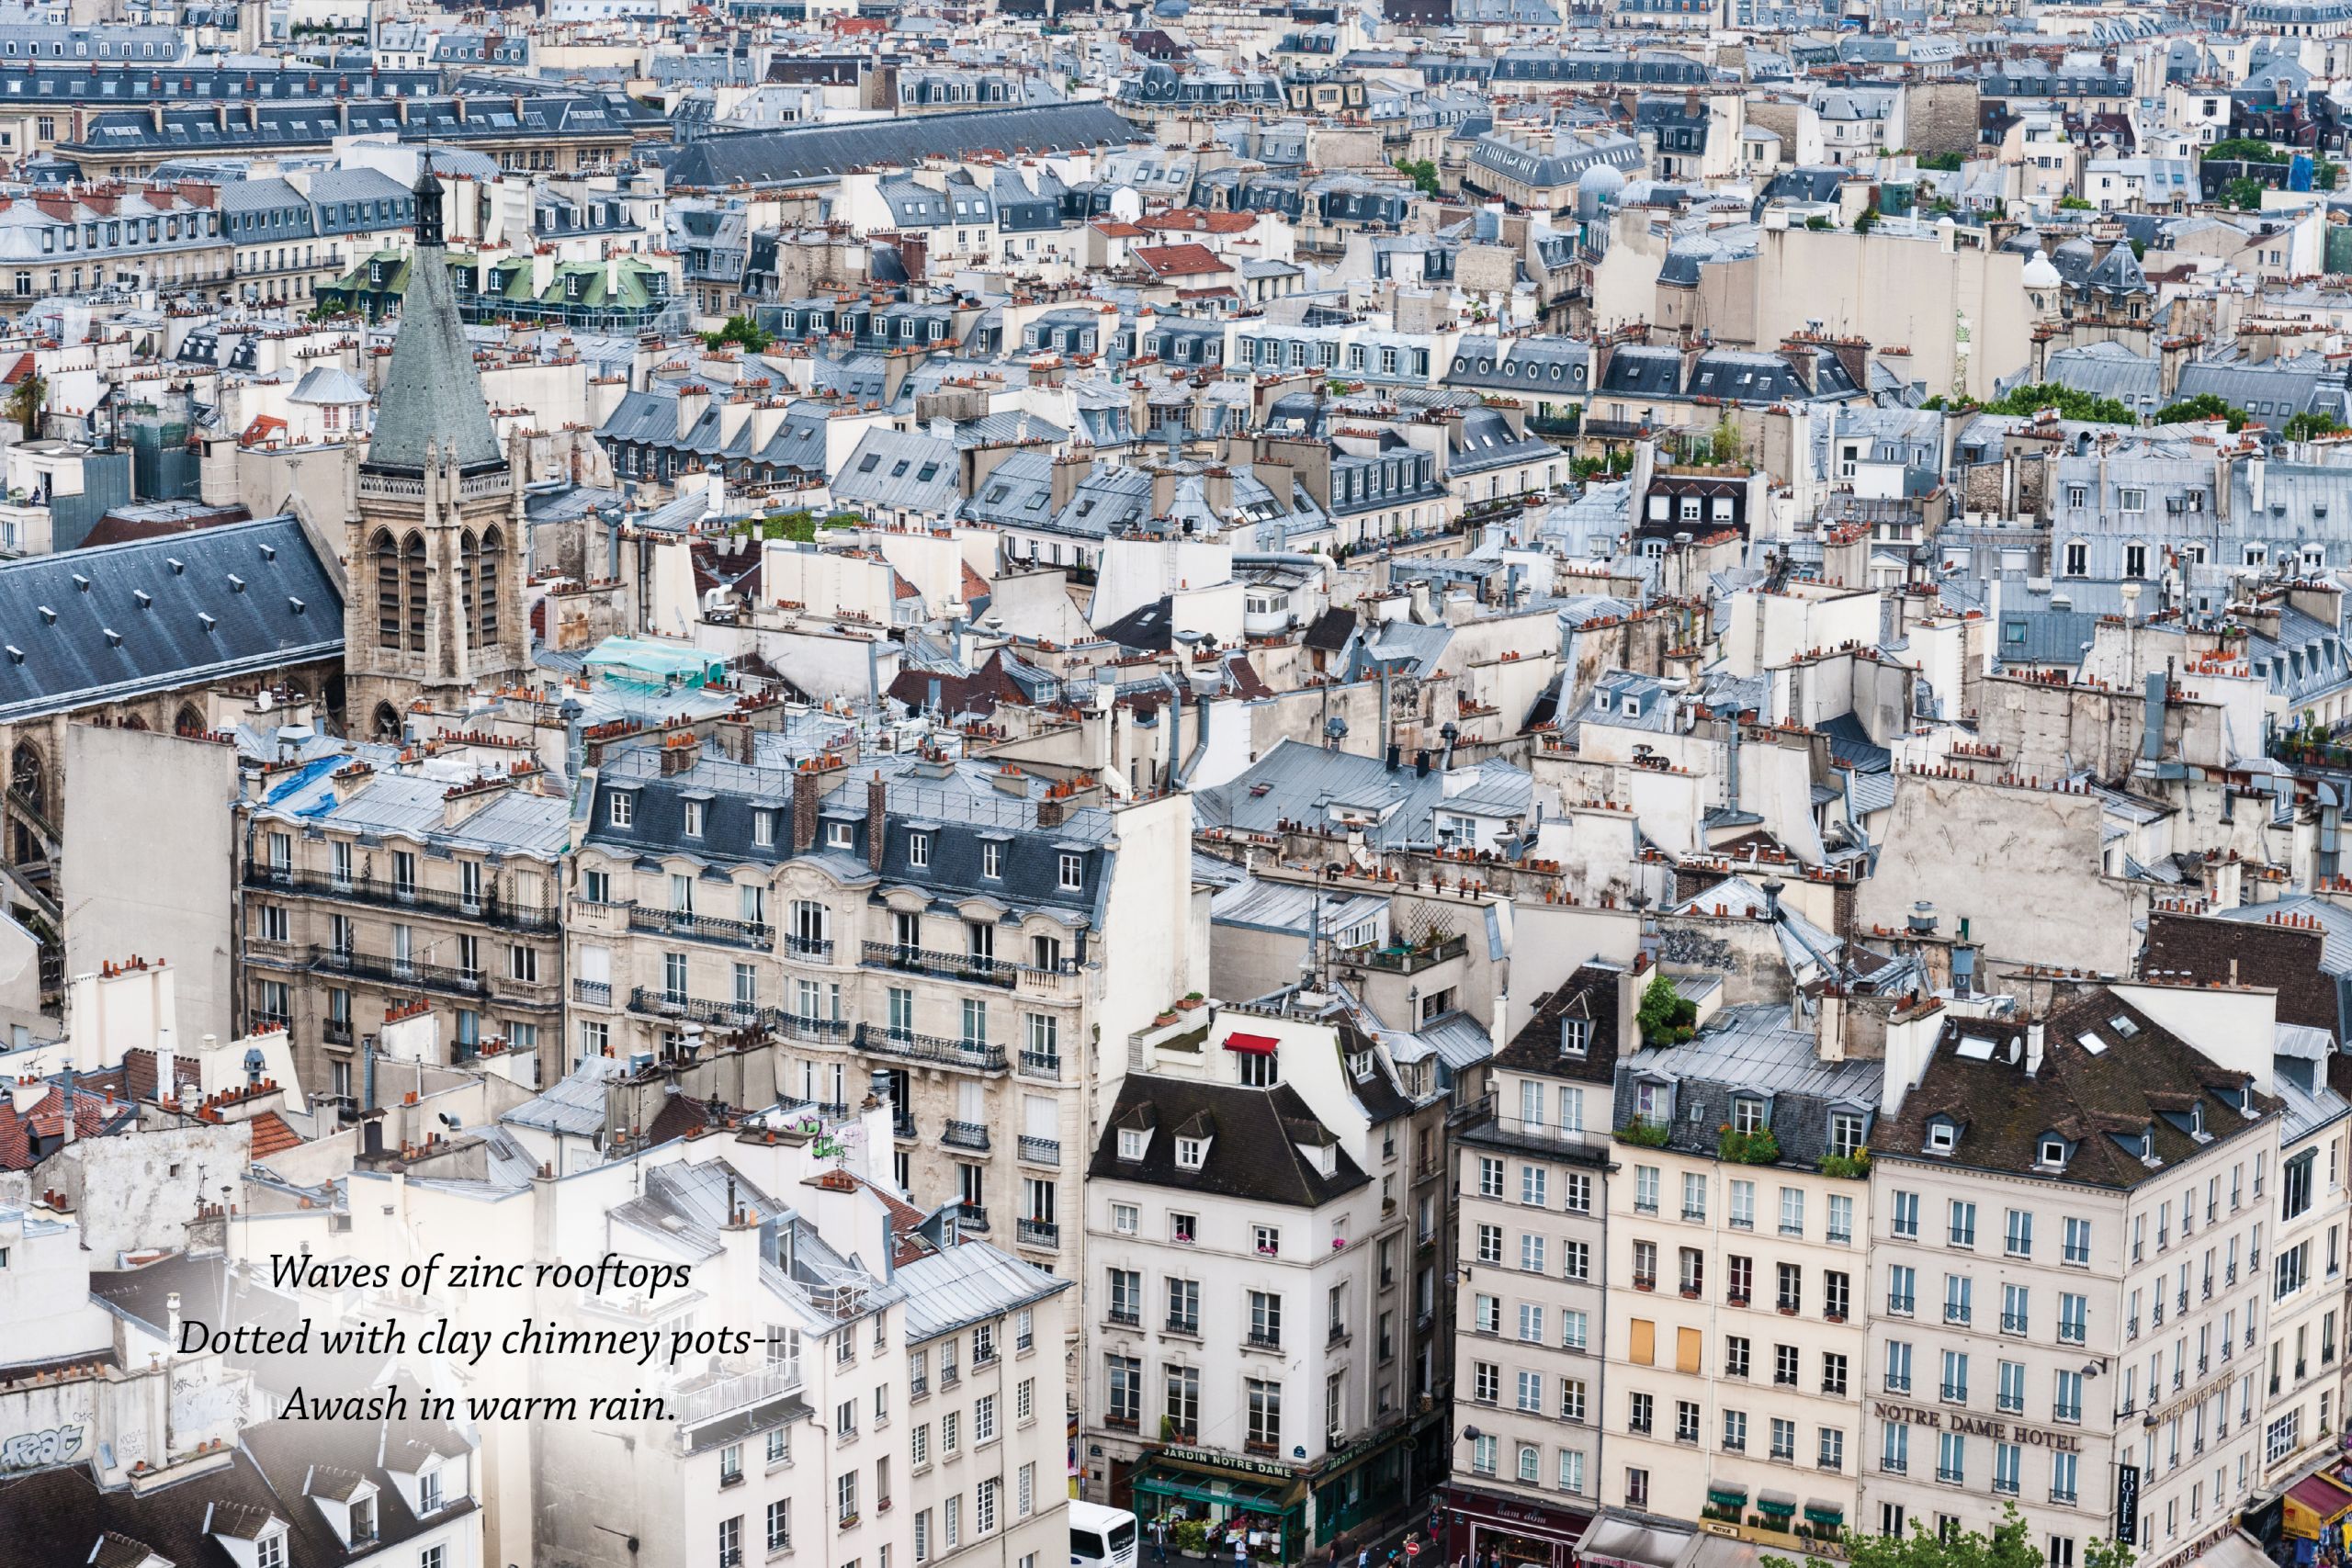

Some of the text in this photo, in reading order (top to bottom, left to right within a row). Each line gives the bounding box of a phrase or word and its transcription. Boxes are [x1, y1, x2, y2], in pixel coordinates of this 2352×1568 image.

[2182, 1390, 2207, 1414] DAME
[2209, 1370, 2237, 1397] HOTEL
[1874, 1402, 2082, 1452] NOTRE DAME HOTEL
[1162, 1448, 1293, 1478] JARDIN NOTRE DAME
[2122, 1469, 2134, 1525] HOTEL
